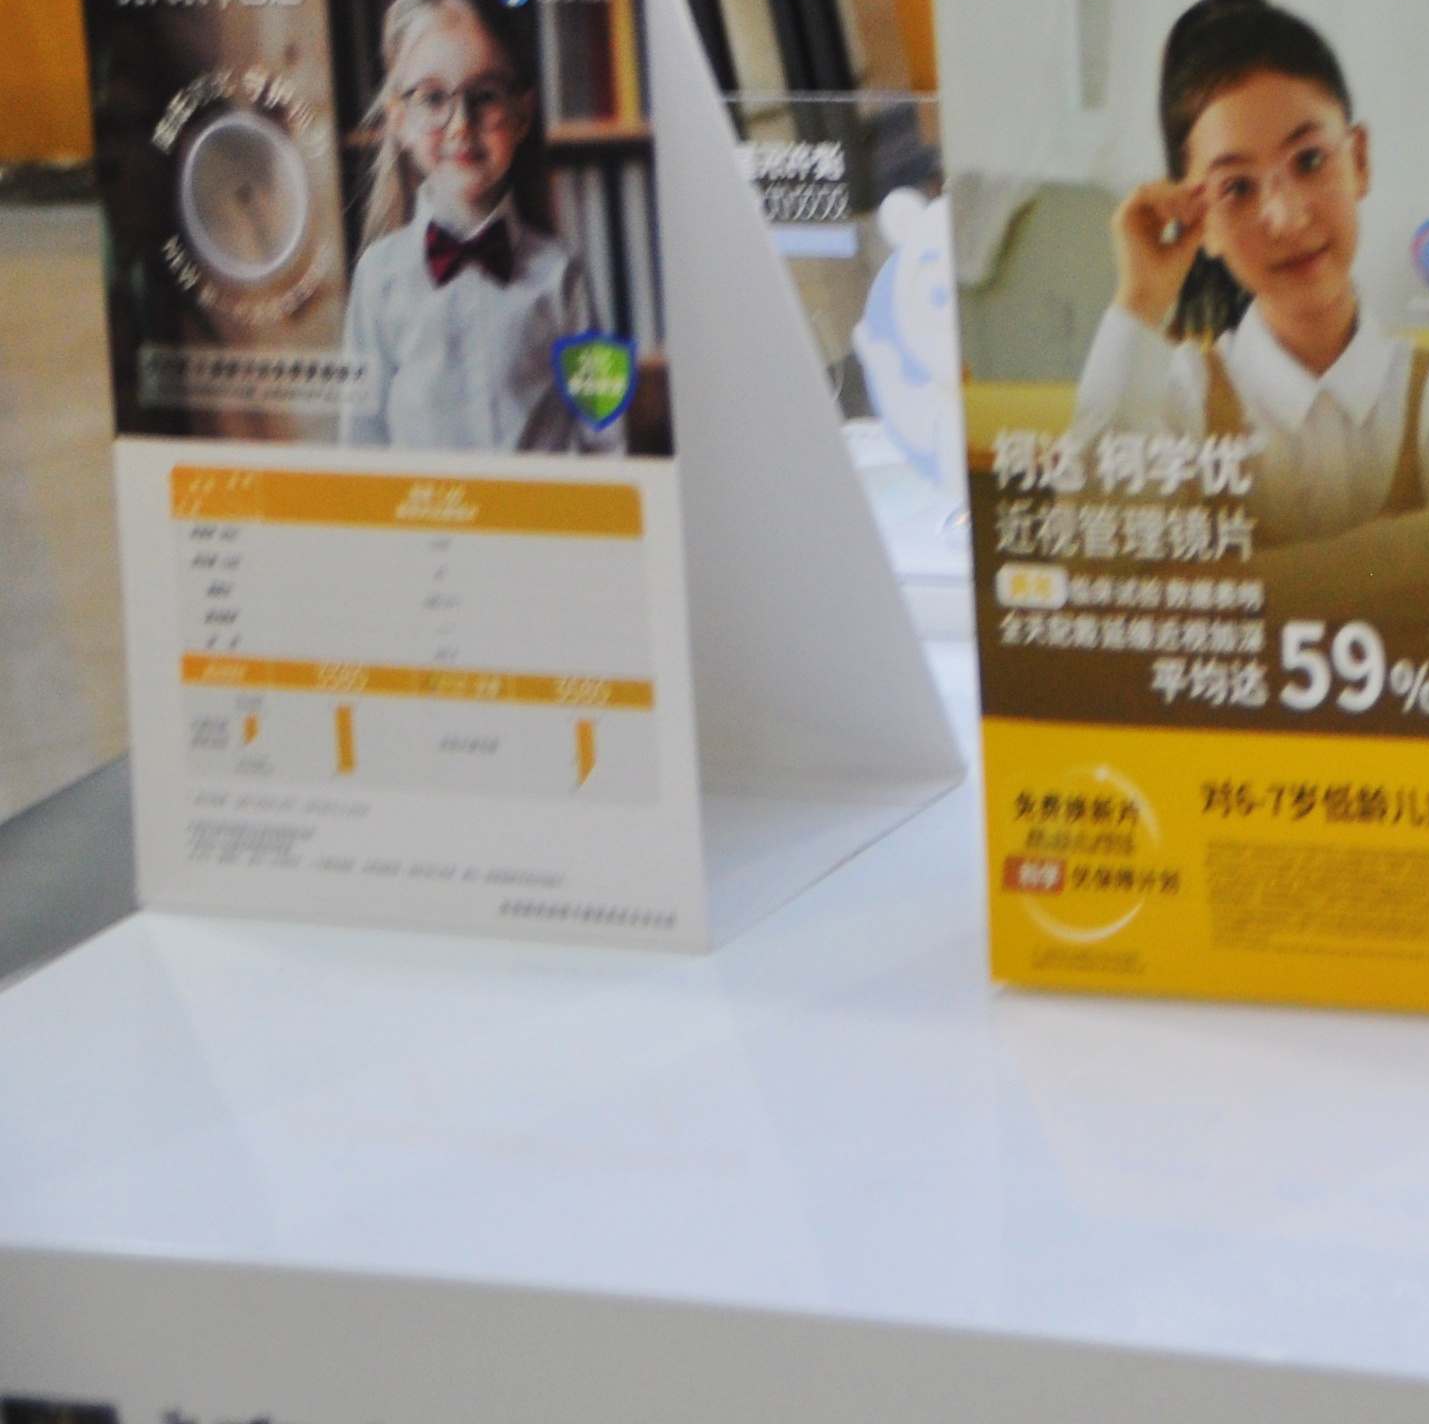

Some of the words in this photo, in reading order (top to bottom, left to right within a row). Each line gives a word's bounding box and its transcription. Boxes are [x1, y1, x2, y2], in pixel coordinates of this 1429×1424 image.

[996, 498, 1257, 562] 近视管理镜片
[1151, 656, 1269, 708] 平均达
